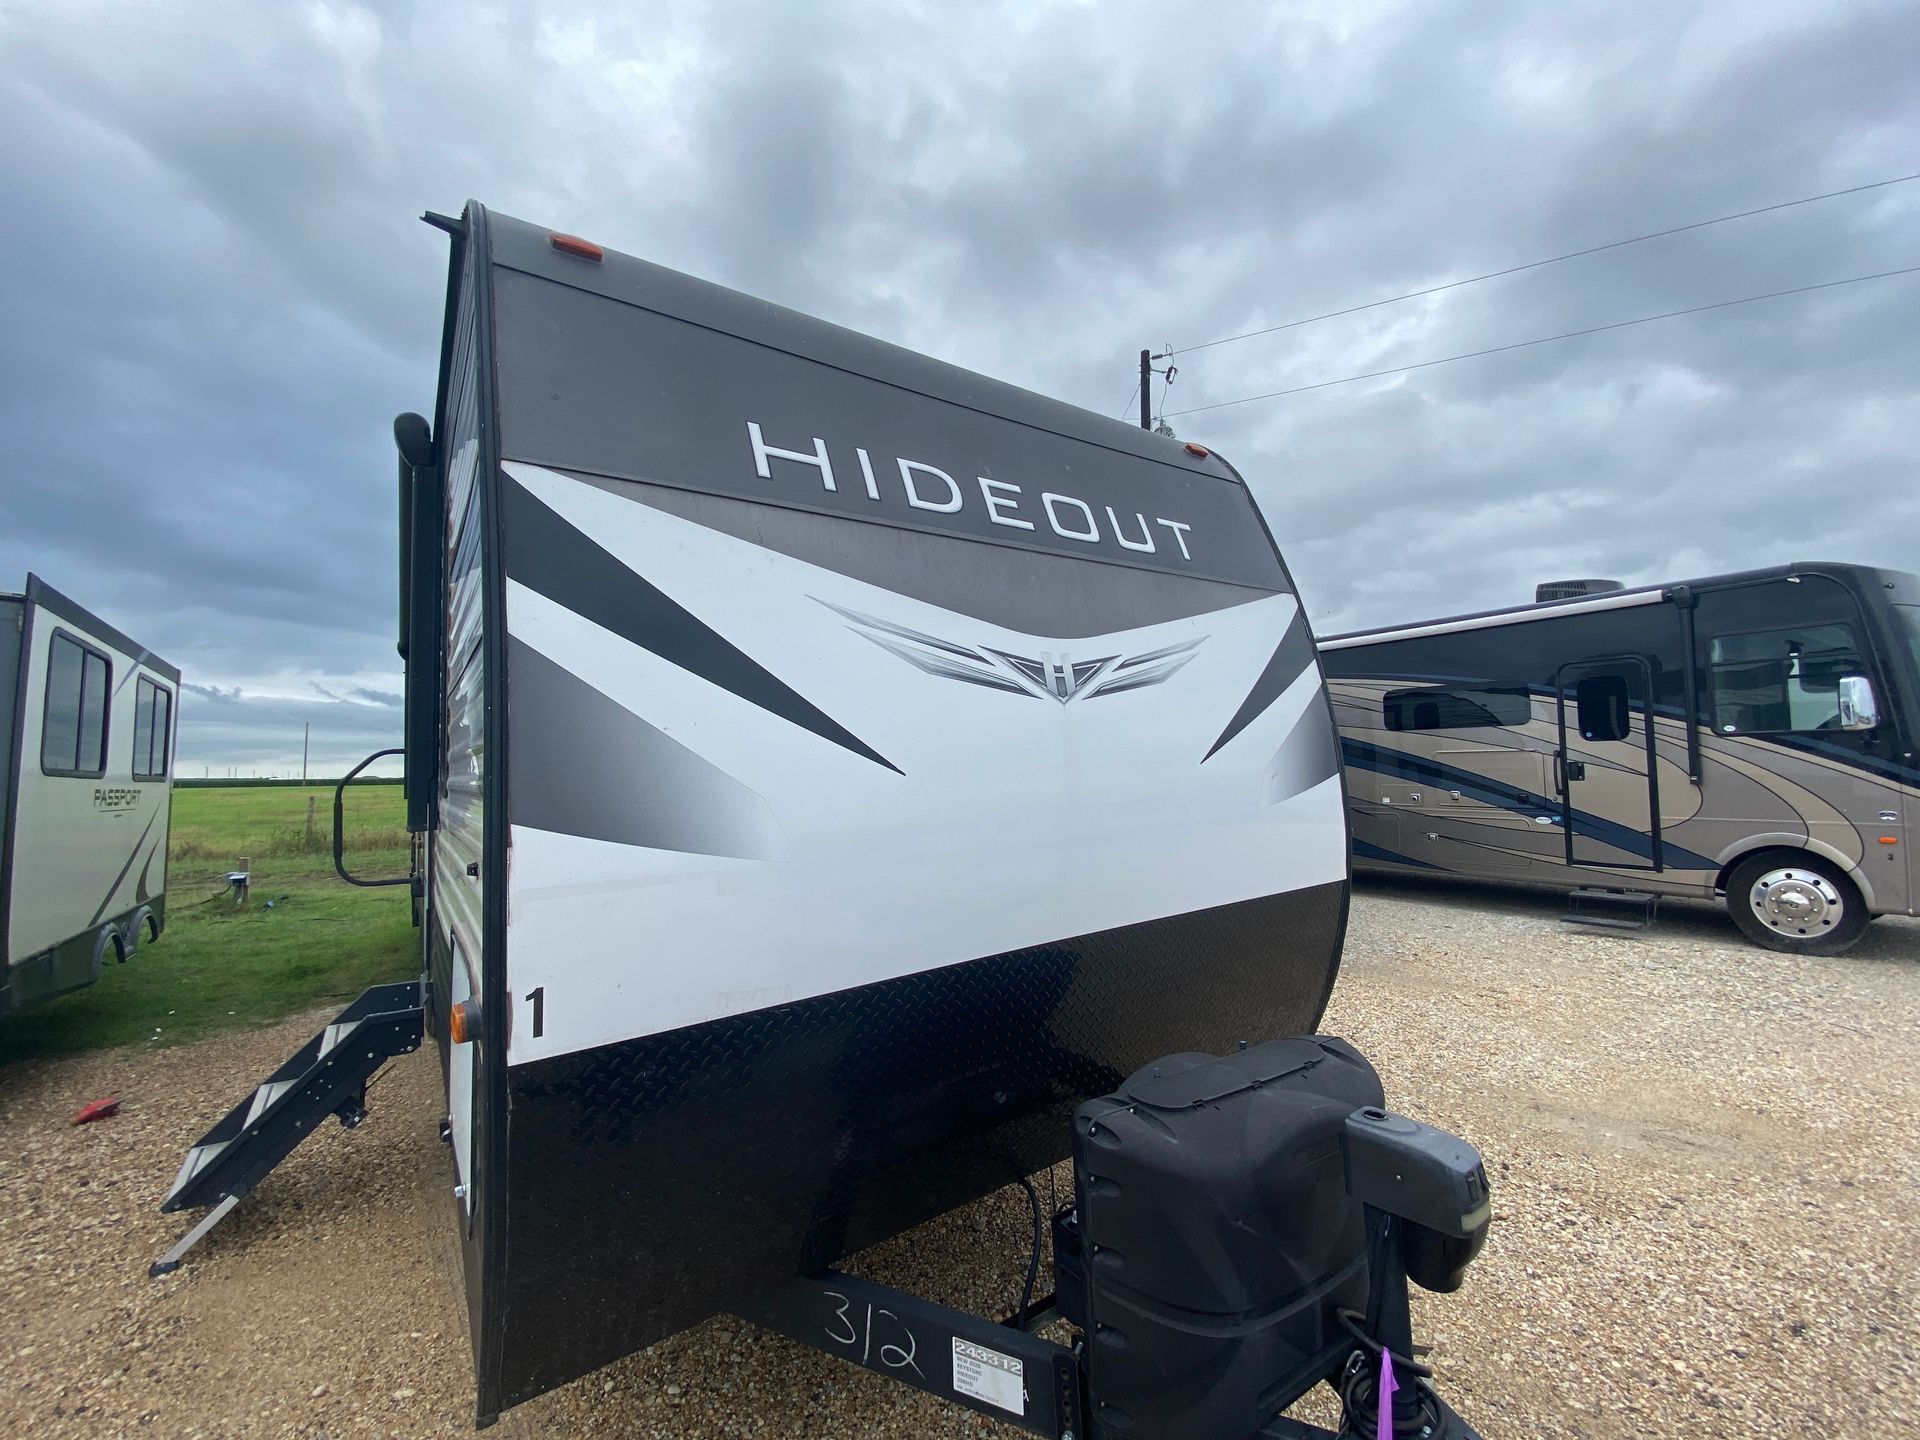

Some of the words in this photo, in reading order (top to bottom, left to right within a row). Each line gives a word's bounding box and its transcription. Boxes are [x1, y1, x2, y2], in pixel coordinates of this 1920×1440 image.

[746, 421, 1192, 561] HIDEOUT
[94, 789, 141, 806] PASSPORT
[525, 987, 544, 1038] 1
[823, 1291, 927, 1381] 312
[955, 1342, 1021, 1374] 243312
